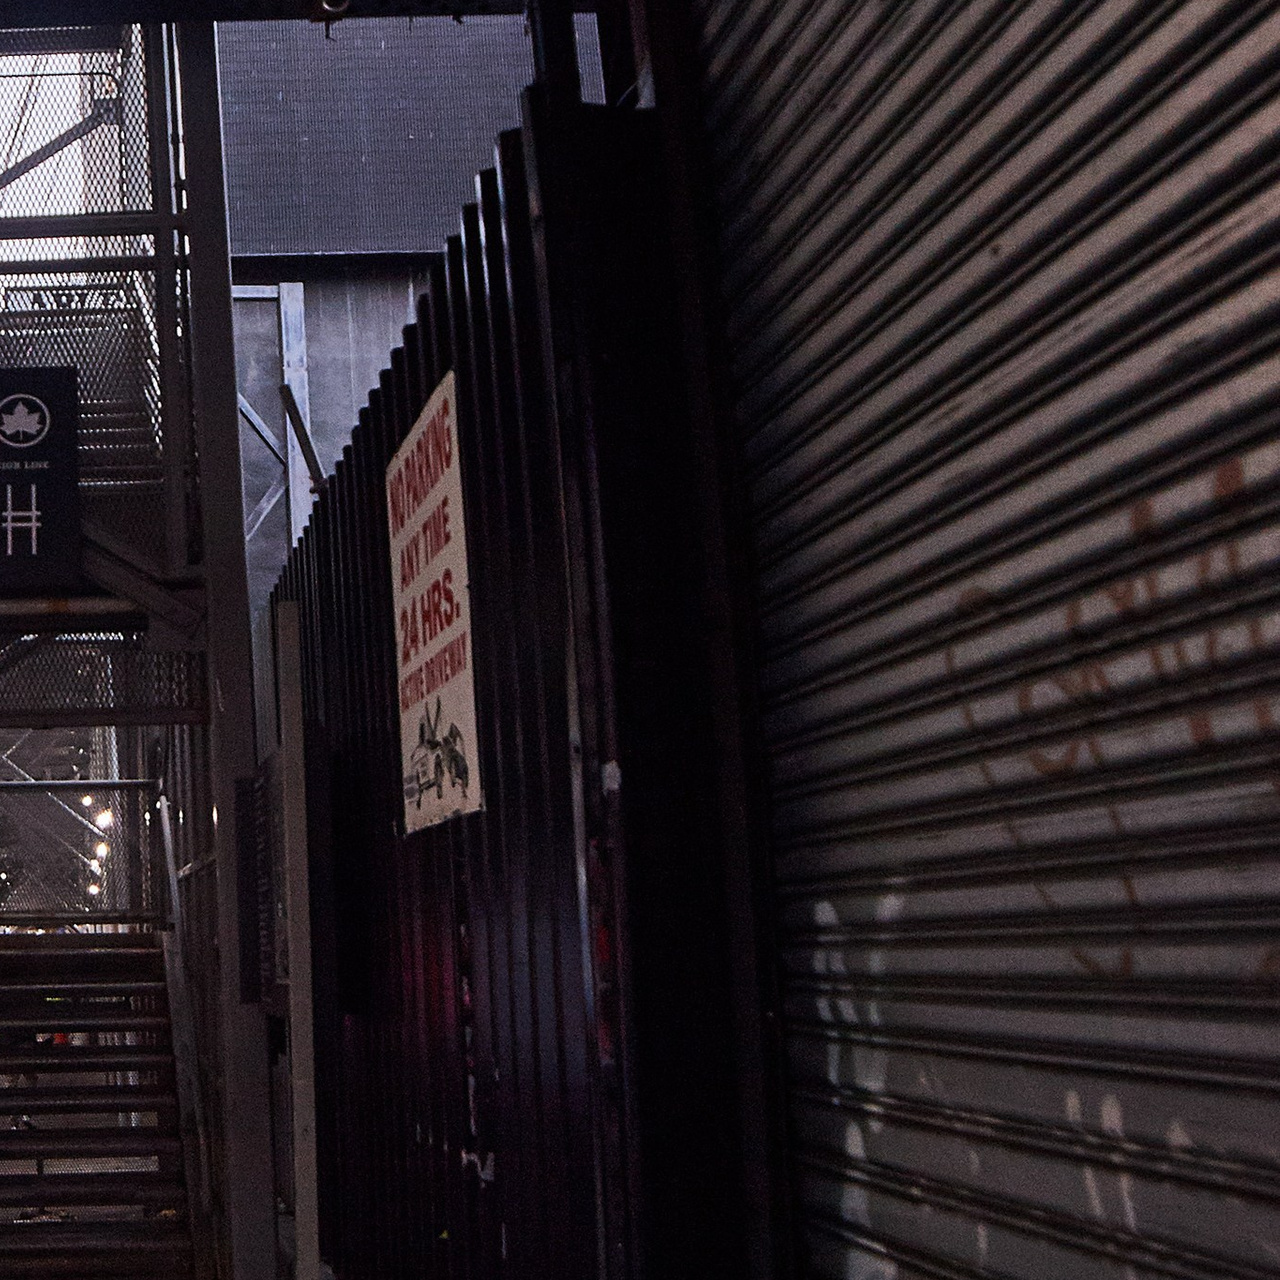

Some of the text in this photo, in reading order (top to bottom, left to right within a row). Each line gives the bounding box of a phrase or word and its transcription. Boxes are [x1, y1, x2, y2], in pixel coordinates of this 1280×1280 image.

[389, 398, 451, 538] NO PARKING
[401, 496, 450, 593] ANY TIME
[401, 568, 460, 668] 24 HRS.
[400, 630, 467, 714] ACTIVE DRIVEWAY
